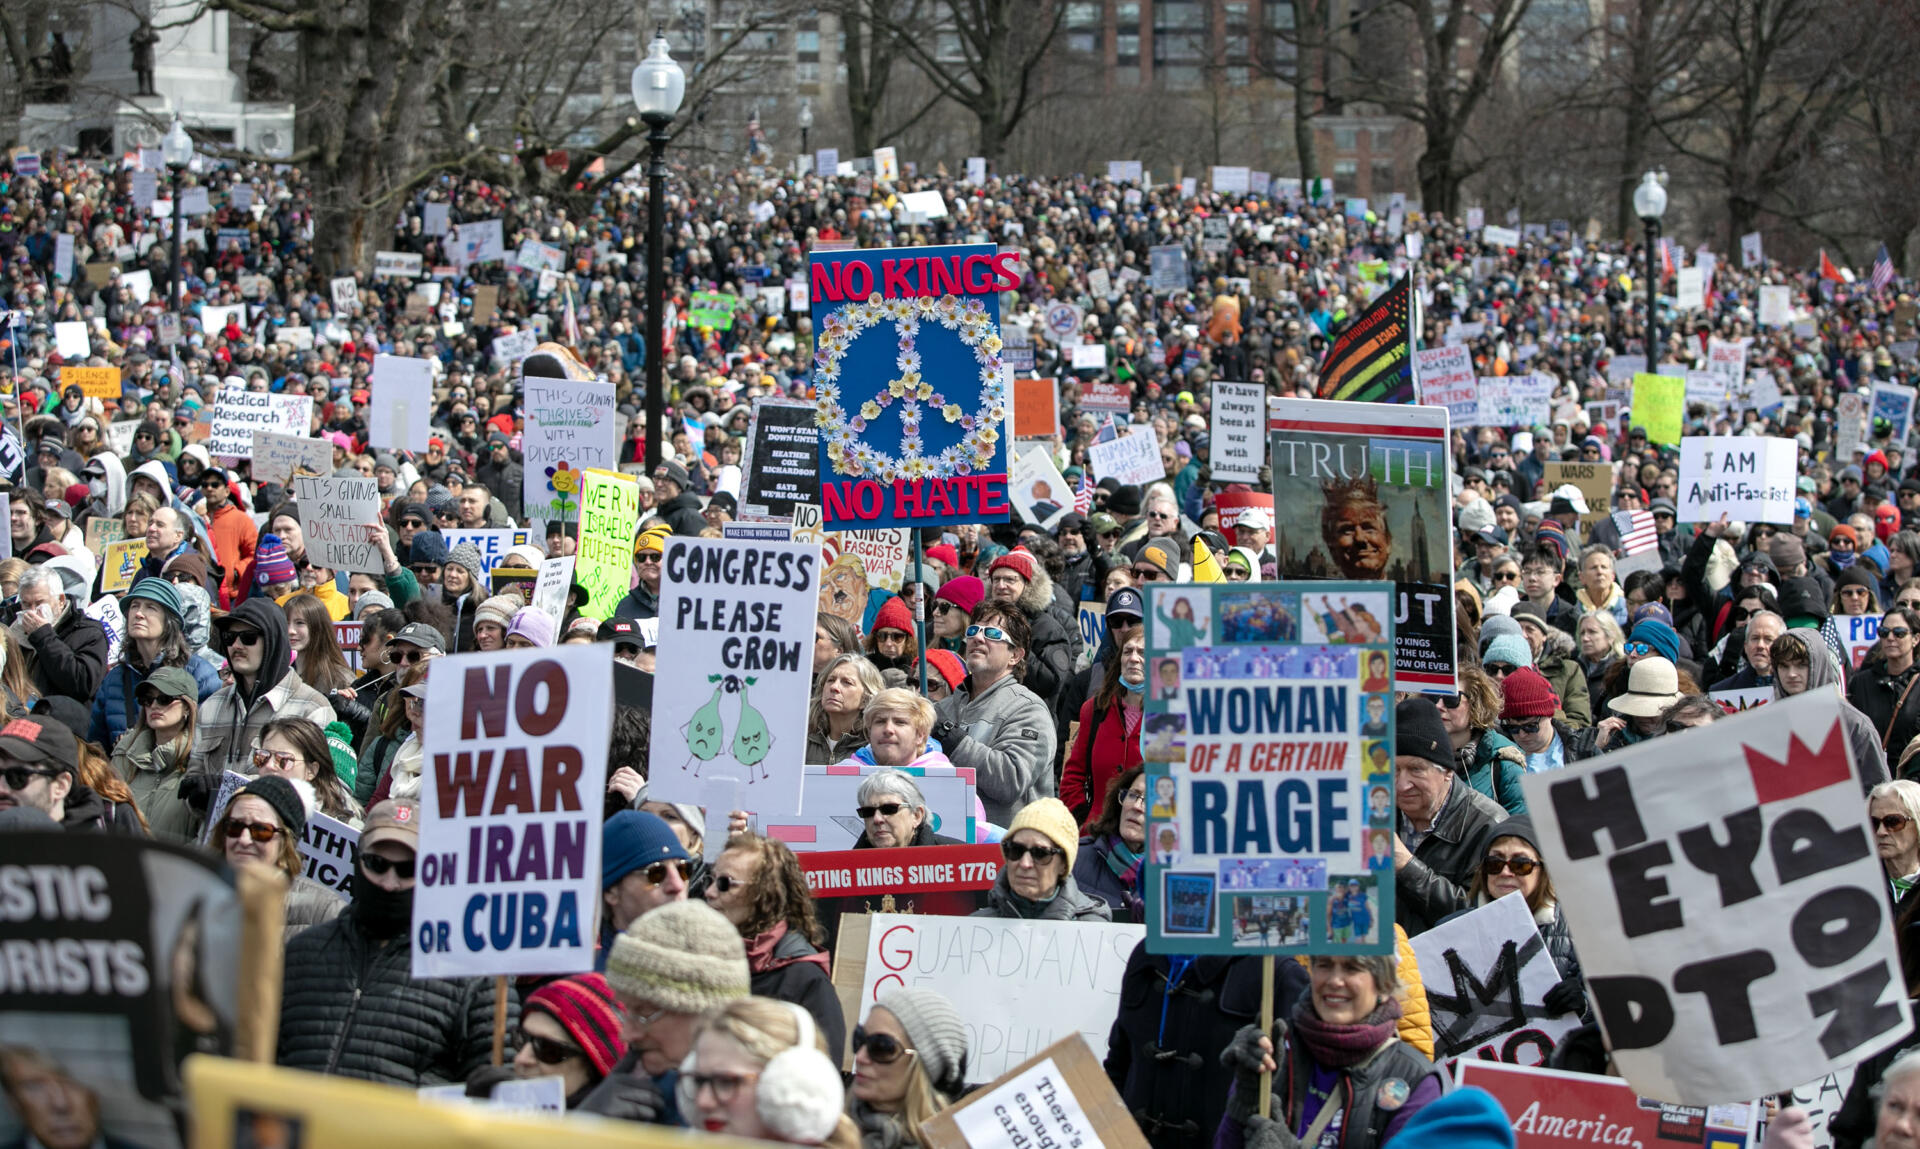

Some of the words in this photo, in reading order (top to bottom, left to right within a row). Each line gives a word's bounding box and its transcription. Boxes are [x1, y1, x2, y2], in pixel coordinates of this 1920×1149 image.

[812, 261, 874, 302] NO
[883, 252, 1020, 300] KINGS
[338, 283, 355, 299] NO
[216, 391, 270, 407] Medical
[535, 388, 572, 405] THIS
[1218, 385, 1232, 396] We
[1235, 387, 1260, 398] have
[213, 407, 280, 424] Research
[537, 408, 591, 422] THRIVES
[1220, 402, 1255, 416] always
[212, 423, 253, 439] Saves
[771, 427, 793, 435] WON'T
[1219, 417, 1239, 427] been
[1242, 418, 1256, 428] at
[545, 429, 576, 441] WITH
[768, 434, 793, 442] DOWN
[1227, 433, 1248, 442] war
[210, 440, 253, 456] Restor
[528, 447, 604, 462] DIVERSITY
[772, 450, 810, 460] HEATHER
[1225, 448, 1248, 459] with
[781, 459, 799, 467] COX
[1214, 463, 1258, 475] Eastasia
[1280, 440, 1433, 488] TRUTH
[1704, 452, 1714, 466] I
[1722, 452, 1755, 471] AM
[762, 466, 816, 477] RICHARDSON
[1560, 465, 1595, 479] WARS
[297, 478, 332, 500] IT'S
[338, 480, 377, 500] GIVING
[760, 490, 785, 500] WE'RE
[787, 491, 811, 501] OKAY
[775, 484, 798, 492] SAYS
[1688, 482, 1789, 506] Anti-Fascist
[612, 486, 621, 512] R
[822, 480, 883, 521] NO
[893, 474, 1009, 519] HATE
[320, 503, 356, 520] SMALL
[795, 506, 818, 528] NO
[726, 530, 740, 538] MAKE
[740, 530, 755, 538] LYING
[756, 531, 773, 539] WRONG
[774, 531, 789, 539] AGAIN
[327, 544, 373, 568] ENERGY
[582, 536, 630, 567] PUPPETS
[844, 541, 903, 561] FASCISTS
[666, 543, 814, 592] CONGRESS
[865, 559, 894, 575] WAR
[677, 597, 782, 632] PLEASE
[1394, 593, 1441, 625] UT
[336, 628, 345, 644] A
[347, 628, 362, 645] DR
[1850, 616, 1883, 641] PO
[1404, 638, 1430, 648] KINGS
[722, 636, 801, 671] GROW
[1399, 649, 1418, 659] THE
[1419, 650, 1436, 660] USA
[1413, 660, 1427, 669] OR
[1429, 661, 1450, 670] EVER
[460, 659, 569, 739] NO
[1187, 686, 1348, 736] WOMAN
[1189, 743, 1213, 774] OF
[1225, 743, 1241, 773] A
[1249, 742, 1349, 772] CERTAIN
[434, 746, 584, 819] WAR
[1191, 777, 1351, 855] RAGE
[422, 853, 458, 887] ON
[467, 821, 588, 884] IRAN
[804, 867, 852, 889] CTING
[856, 865, 904, 887] KINGS
[908, 863, 954, 885] SINCE
[958, 862, 997, 881] 1776
[0, 865, 112, 921] STIC
[419, 921, 452, 954] OR
[463, 890, 583, 953] CUBA
[0, 938, 150, 996] RISTS
[879, 925, 1144, 995] GUARDIANS
[1036, 1076, 1083, 1149] There's
[1663, 1103, 1705, 1117] HEALTH
[1013, 1091, 1062, 1149] enoug
